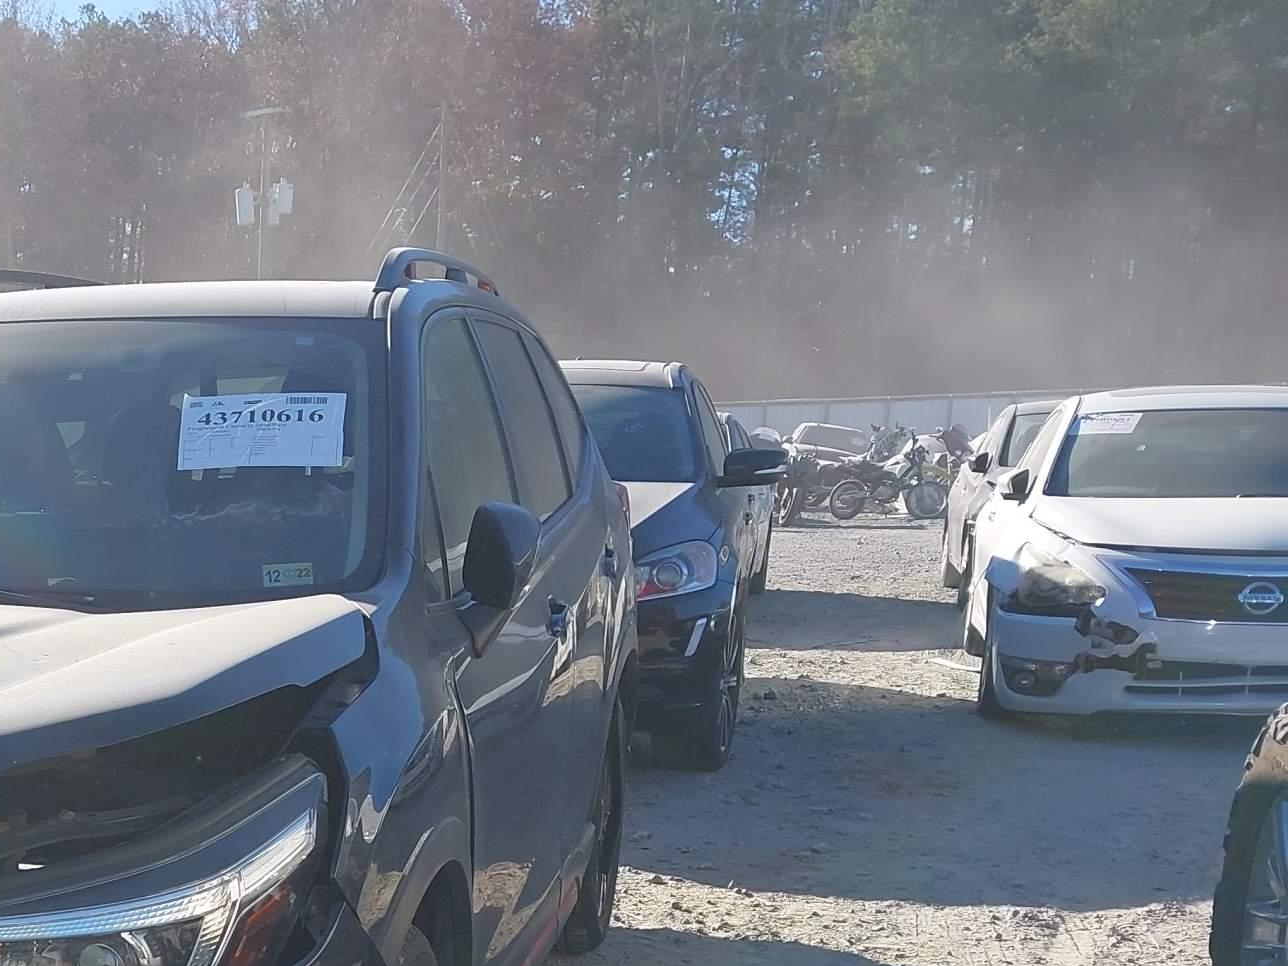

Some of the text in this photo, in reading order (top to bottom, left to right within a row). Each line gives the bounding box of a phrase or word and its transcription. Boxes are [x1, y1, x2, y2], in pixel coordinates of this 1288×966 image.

[198, 409, 324, 425] 43710616
[265, 568, 311, 583] 12 22
